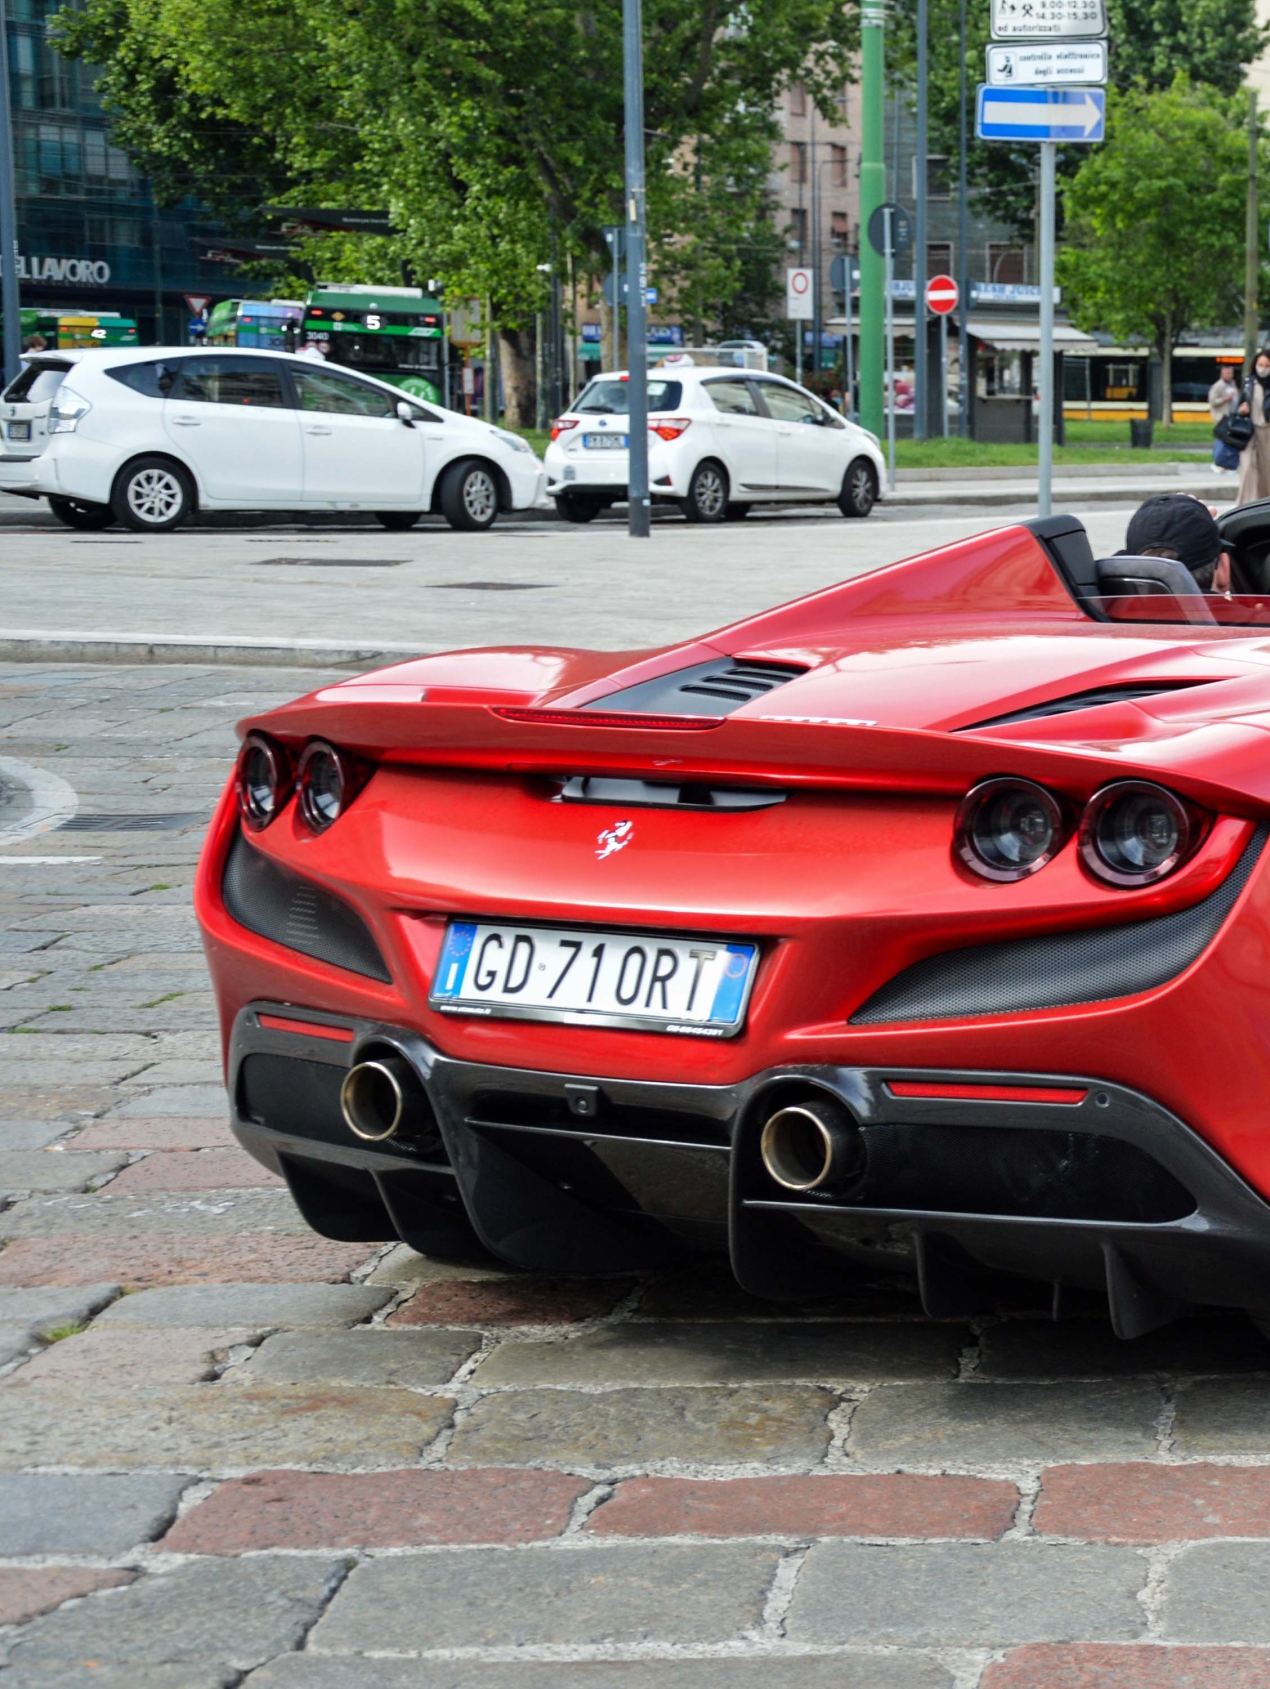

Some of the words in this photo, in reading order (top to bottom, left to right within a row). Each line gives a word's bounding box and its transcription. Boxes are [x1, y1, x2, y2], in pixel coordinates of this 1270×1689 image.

[998, 24, 1008, 32] ed
[1012, 24, 1061, 32] autorizzati
[1019, 52, 1052, 61] controllo
[1056, 51, 1100, 60] elettronico
[1035, 67, 1052, 76] degli
[1056, 67, 1084, 75] accessi
[366, 314, 381, 330] 5
[473, 932, 536, 994] GD
